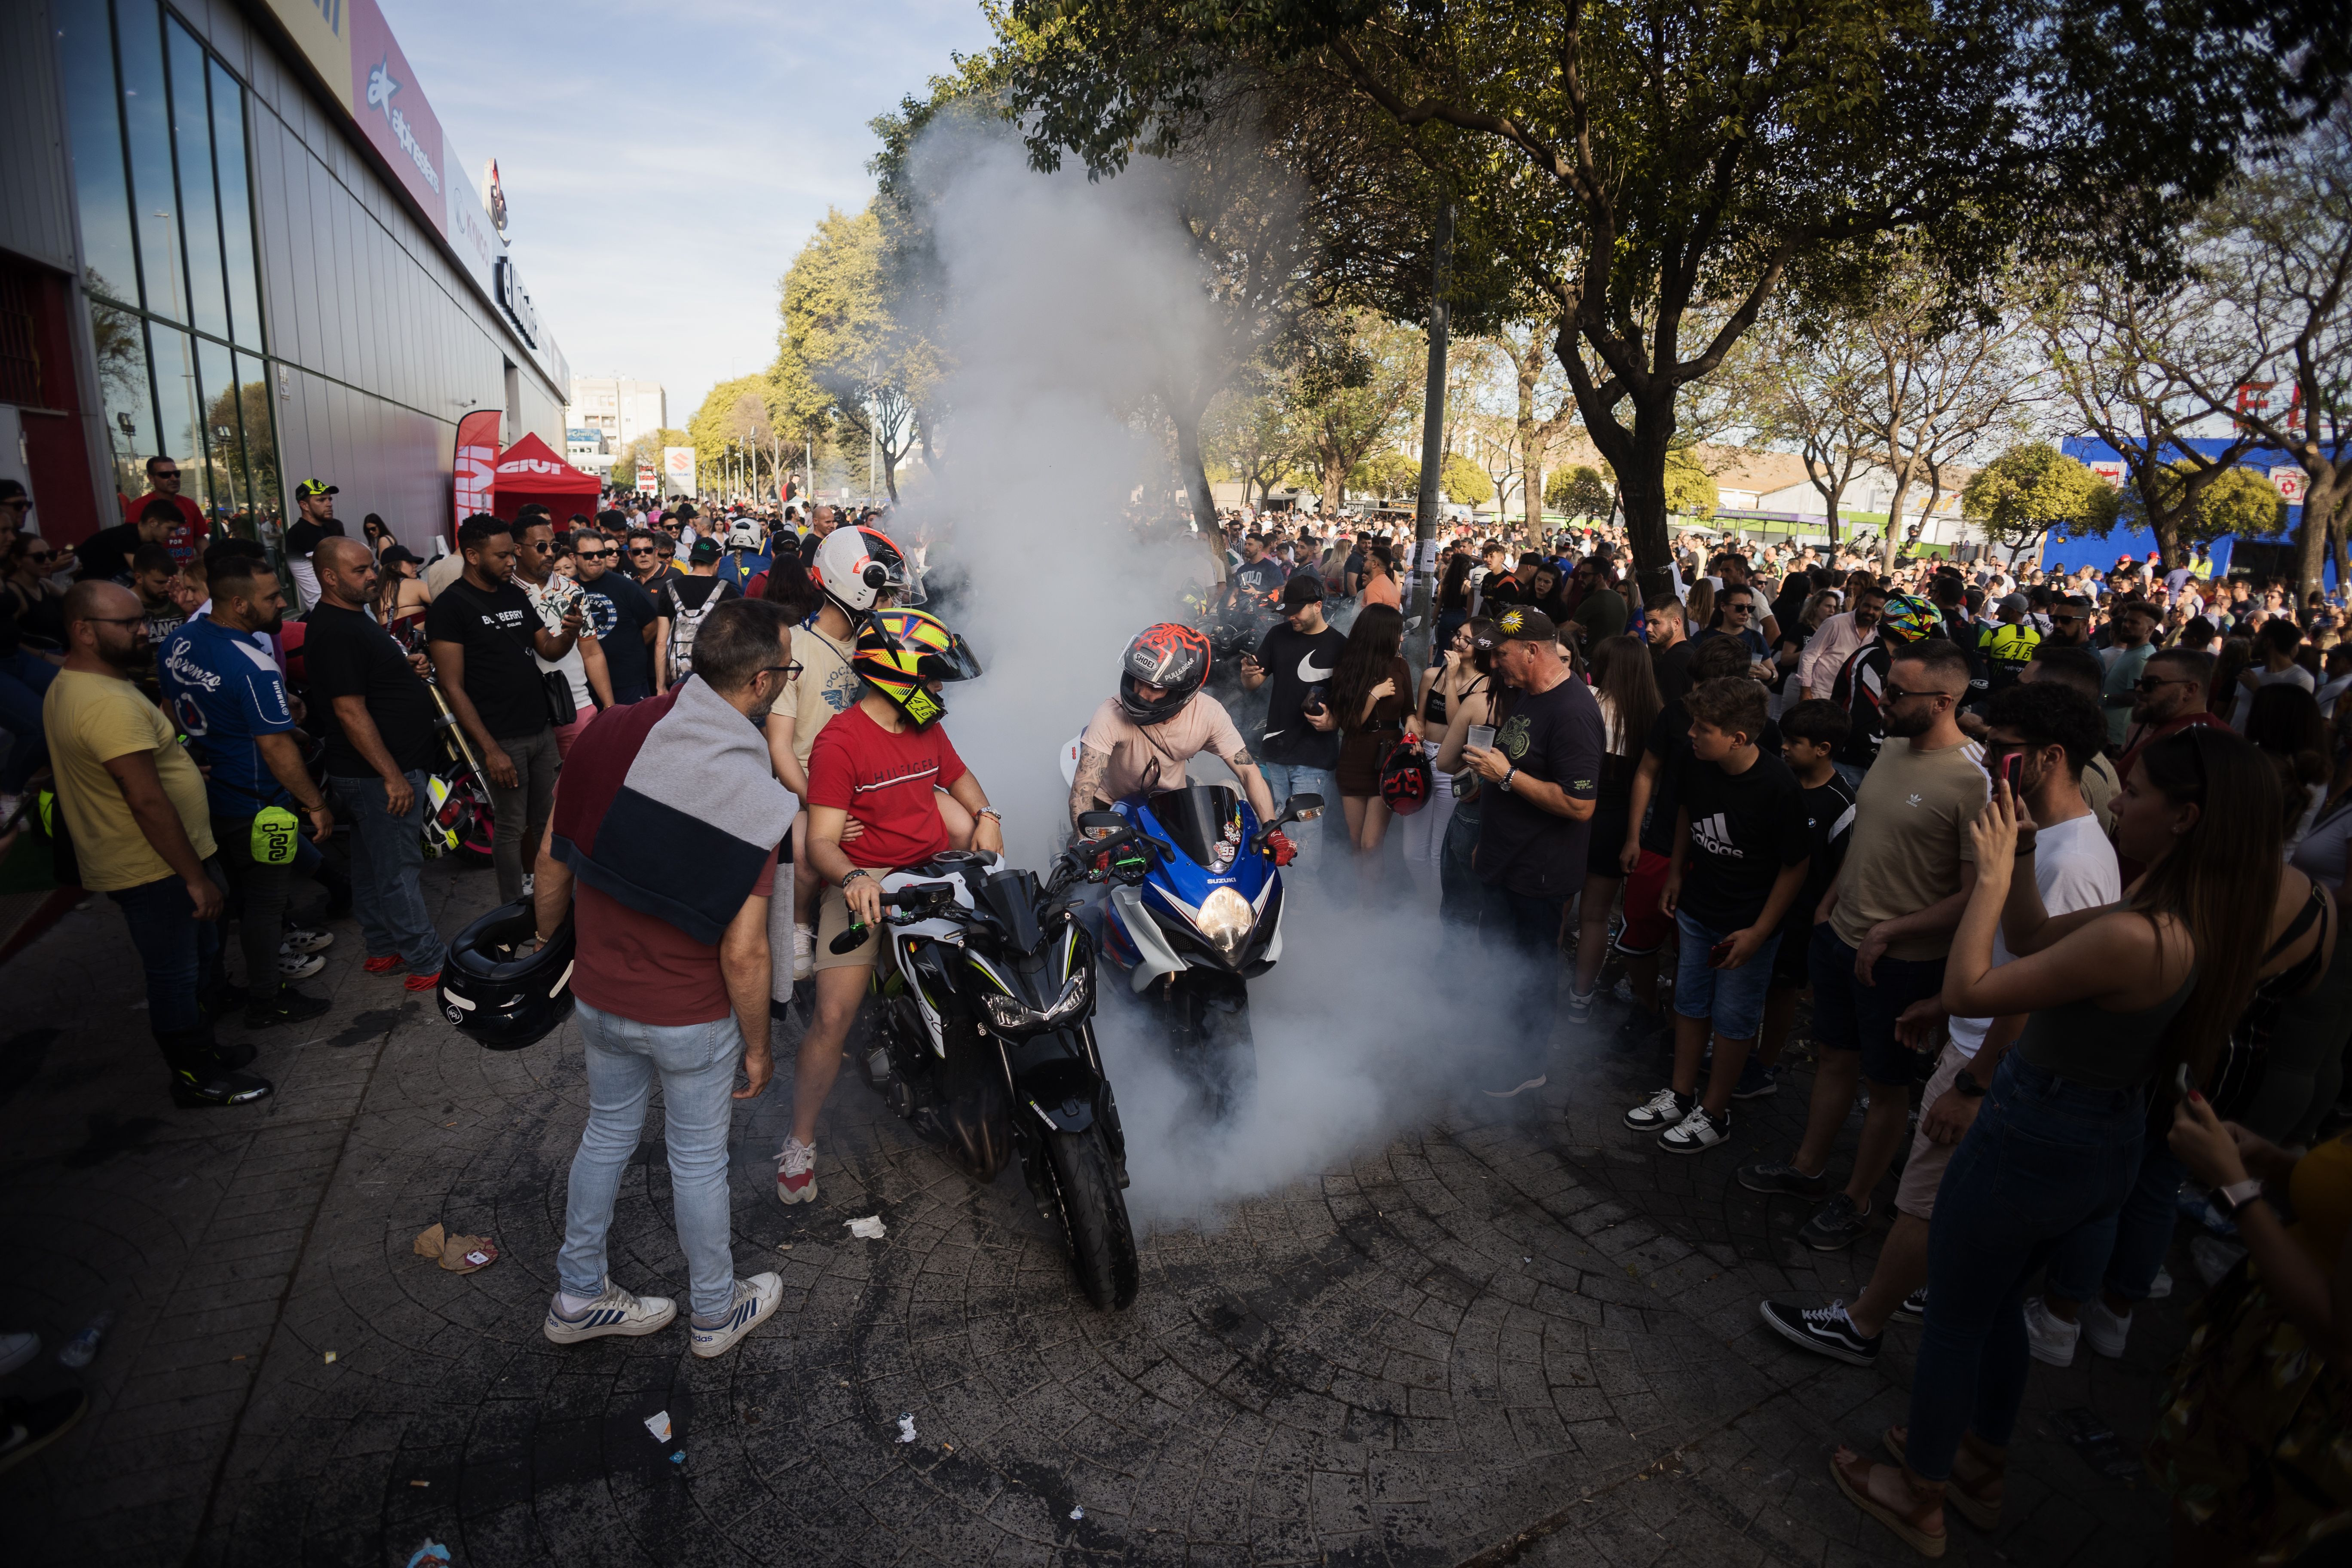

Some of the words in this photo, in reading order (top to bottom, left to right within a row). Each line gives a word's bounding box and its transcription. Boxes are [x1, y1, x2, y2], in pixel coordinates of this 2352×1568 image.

[392, 108, 440, 194] alpinestars
[466, 209, 489, 267] KYMCO
[496, 459, 560, 475] GIVI
[1135, 654, 1155, 669] SHOEI
[1993, 640, 2037, 662] 46
[165, 637, 221, 692] Lorenzo
[1164, 658, 1195, 681] PULL&BEAR
[272, 680, 286, 709] YAMAHA
[906, 697, 936, 720] 46
[874, 759, 934, 784] HILFIGER
[1222, 846, 1235, 856] 93
